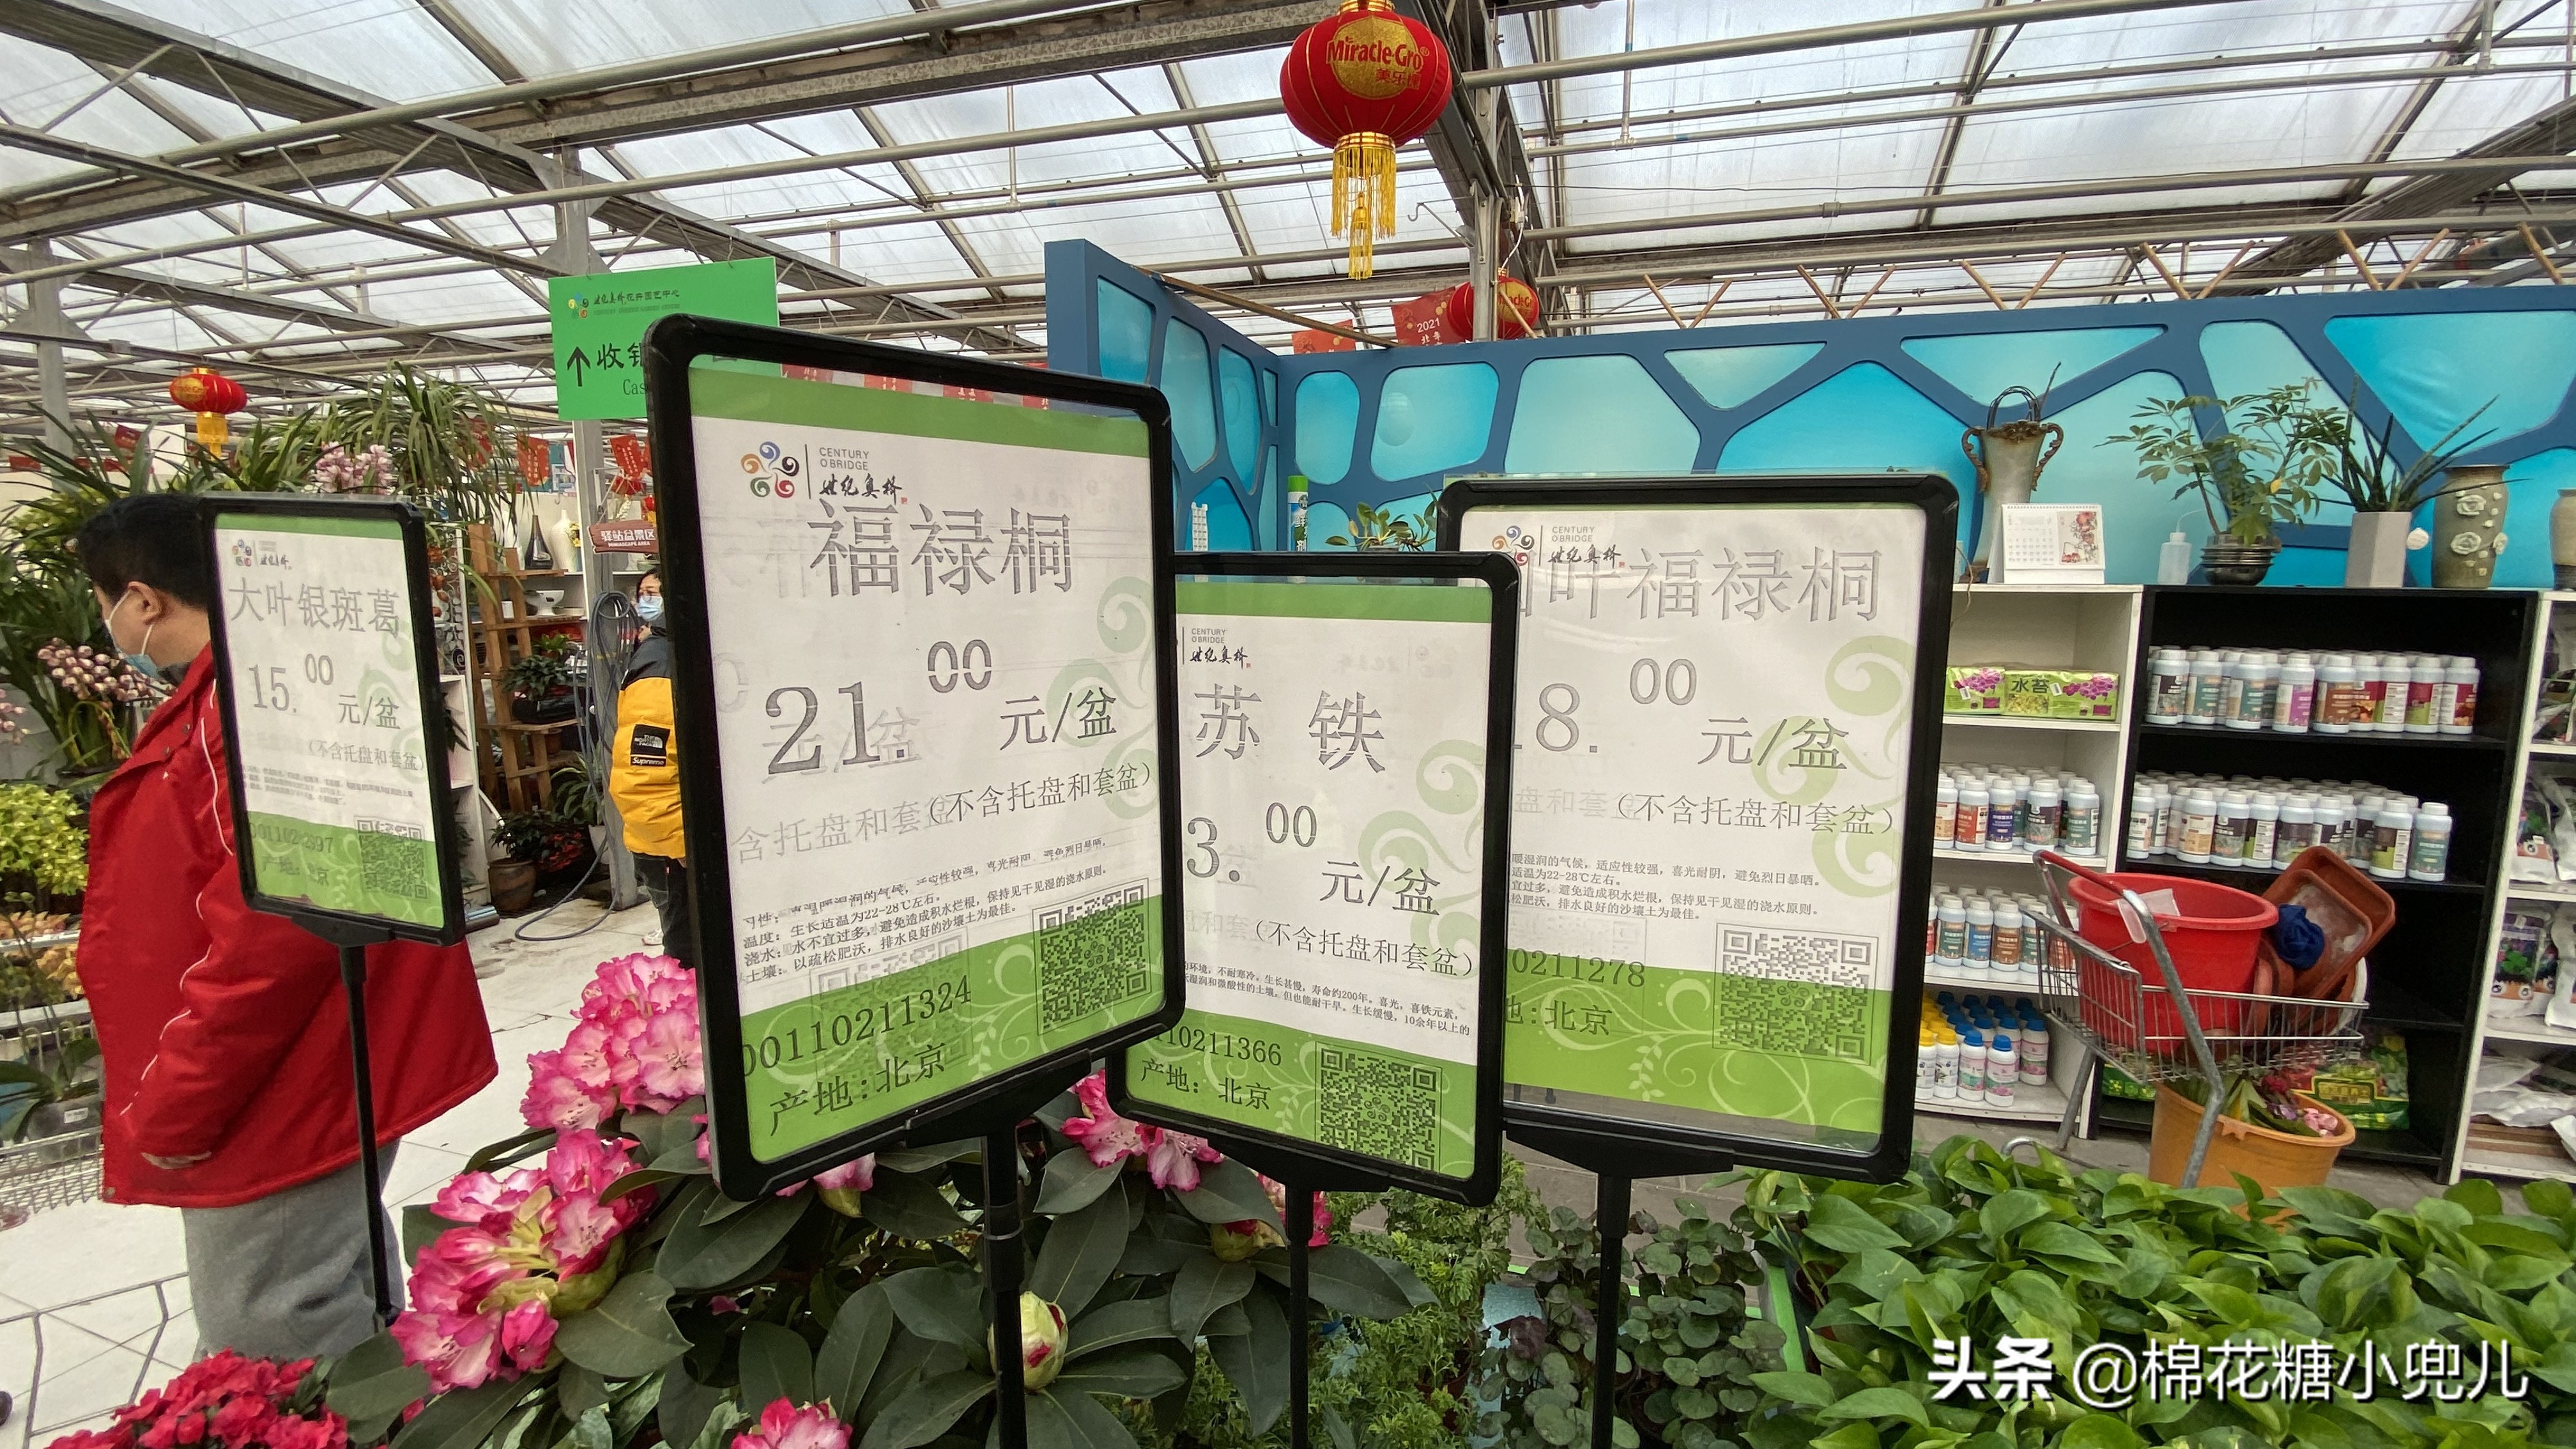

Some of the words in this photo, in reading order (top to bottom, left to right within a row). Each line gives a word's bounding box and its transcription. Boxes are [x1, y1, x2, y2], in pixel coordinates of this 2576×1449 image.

[1416, 317, 1440, 334] 2021
[819, 447, 870, 459] CENTURY
[807, 498, 1072, 597] 福禄桐
[229, 577, 401, 638] 大叶银斑葛
[1521, 546, 1882, 622] 叶福禄桐
[305, 654, 334, 686] 00
[339, 694, 401, 730] 元/盆
[928, 640, 992, 693] 00
[999, 687, 1117, 751] 元/盆
[1630, 658, 1698, 705] 00
[1698, 717, 1849, 769] 元/盆
[2012, 678, 2050, 694] 水苔
[632, 757, 664, 765] Supreme
[1266, 802, 1316, 847] 00
[1320, 860, 1441, 916] 元/盆
[1512, 948, 1645, 987] 0211278
